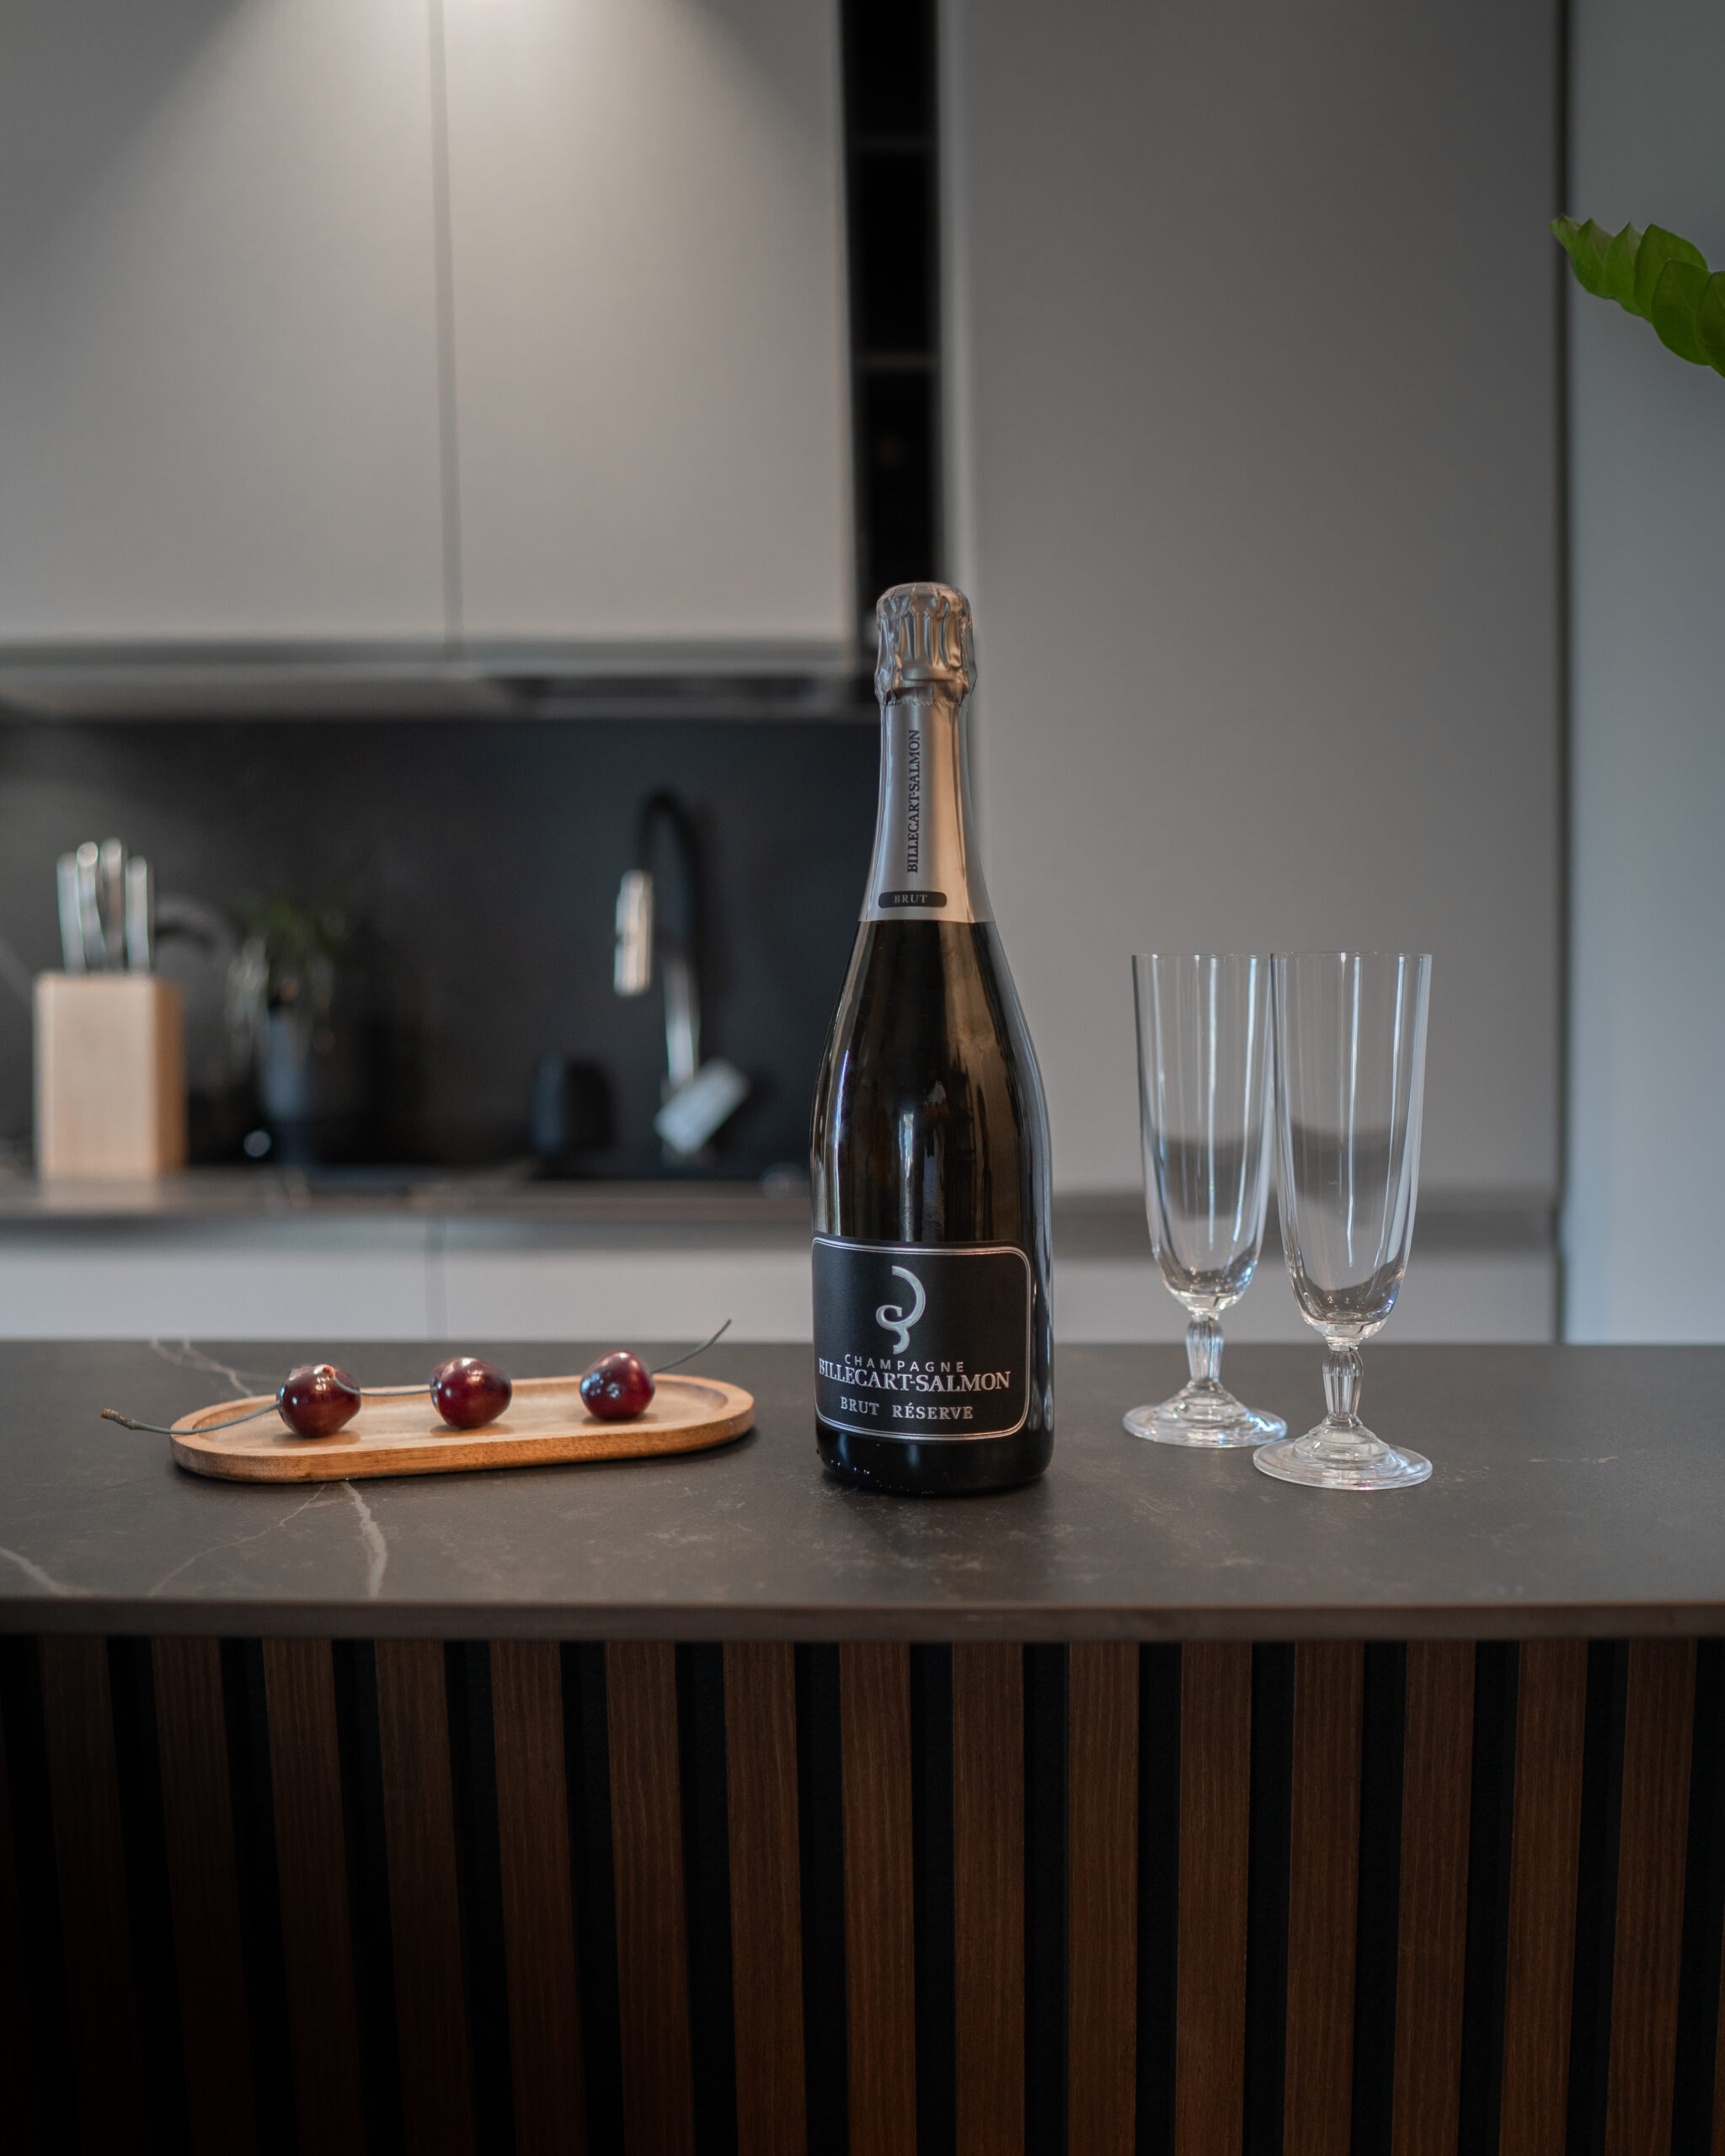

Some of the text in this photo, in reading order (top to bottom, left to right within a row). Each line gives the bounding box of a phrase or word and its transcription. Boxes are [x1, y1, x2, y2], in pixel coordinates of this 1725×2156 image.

[907, 729, 921, 873] BILLECART-SALMON
[894, 894, 928, 905] BRUT
[818, 1358, 1011, 1392] BILLECART-SALMON
[845, 1353, 964, 1373] CHAMPAGNE
[841, 1396, 974, 1420] BRUT RÉSERVE
